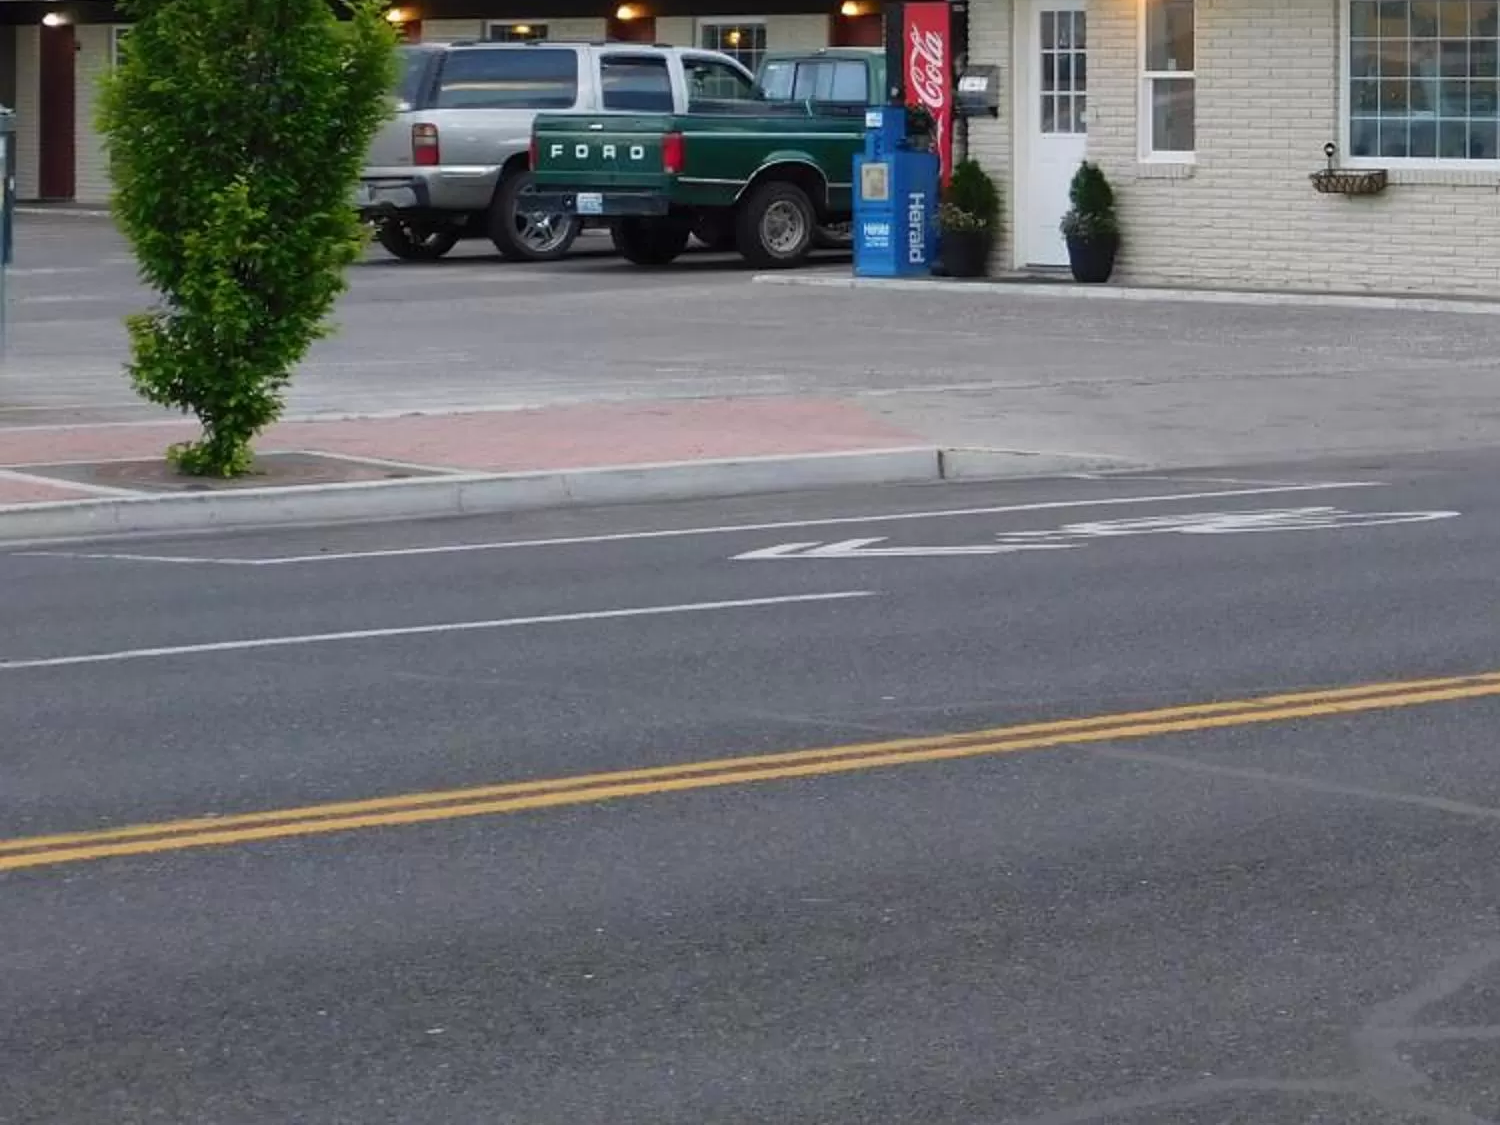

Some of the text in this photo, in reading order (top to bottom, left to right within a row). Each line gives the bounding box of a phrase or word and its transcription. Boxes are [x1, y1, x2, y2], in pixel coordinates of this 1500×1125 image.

[910, 22, 944, 108] Cola
[550, 143, 645, 160] FORD
[908, 192, 925, 264] Herald
